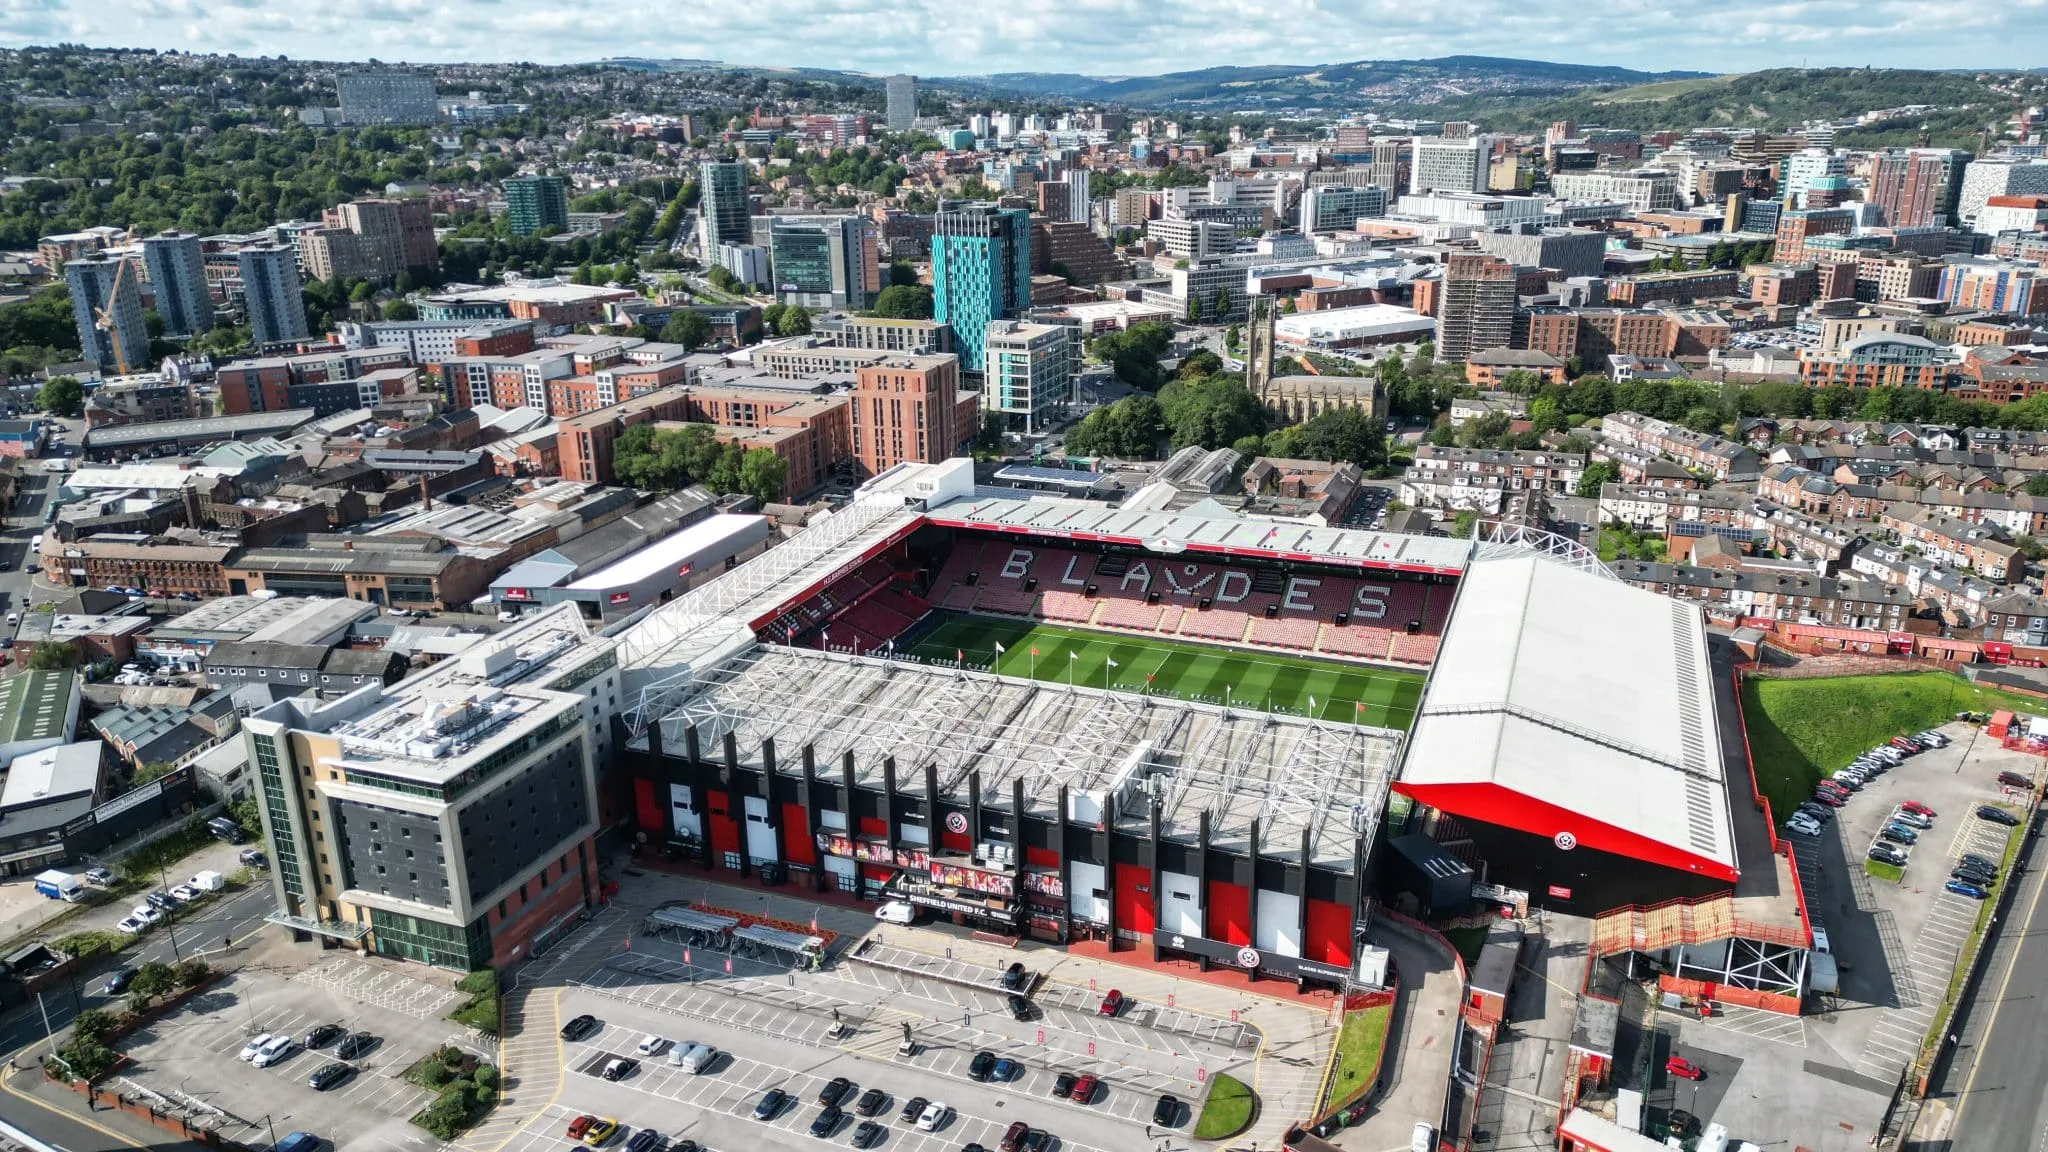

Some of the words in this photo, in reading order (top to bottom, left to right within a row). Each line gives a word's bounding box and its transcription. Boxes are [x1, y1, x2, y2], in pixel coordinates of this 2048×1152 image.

[1001, 549, 1393, 618] BLADES
[909, 895, 947, 908] SHEFFIELD
[946, 902, 973, 914] UNITED
[974, 907, 988, 917] F.C.
[1298, 965, 1317, 973] BLADES
